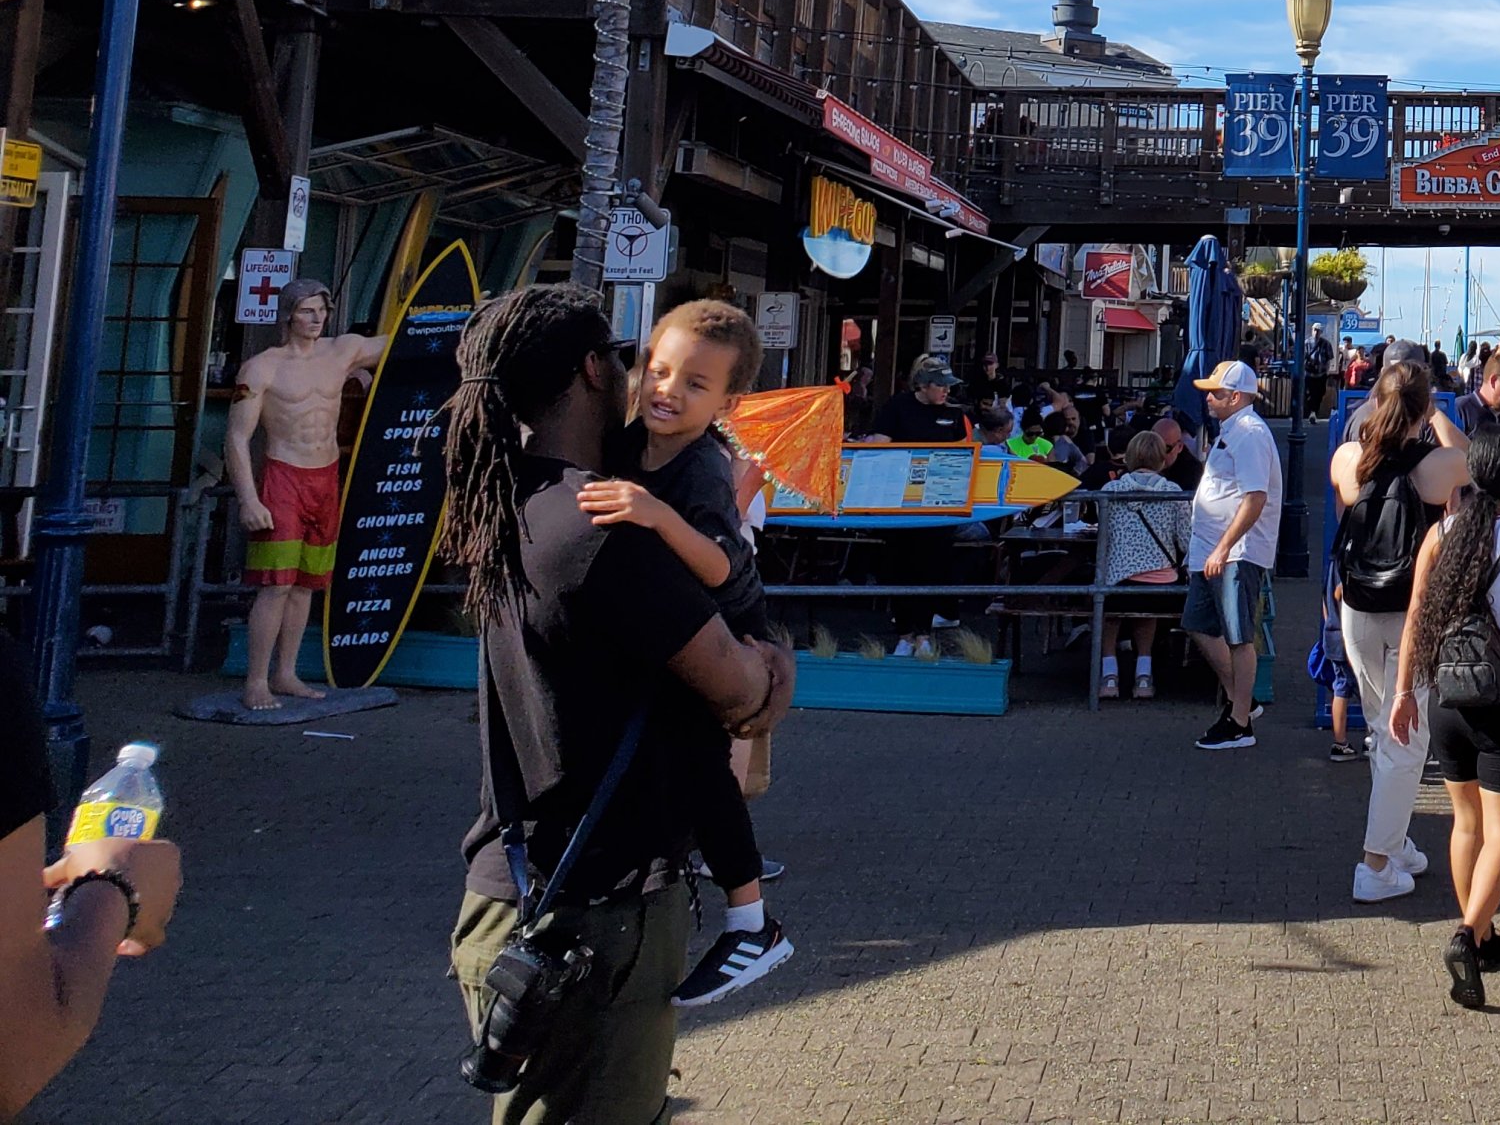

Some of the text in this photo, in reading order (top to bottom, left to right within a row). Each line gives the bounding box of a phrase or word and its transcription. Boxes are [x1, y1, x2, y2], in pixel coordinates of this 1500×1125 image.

[1234, 92, 1286, 111] PIER
[1326, 93, 1378, 113] PIER
[1230, 113, 1288, 157] 39
[1323, 115, 1380, 158] 39
[1482, 148, 1500, 162] End
[1415, 168, 1481, 195] BUBBA
[263, 254, 275, 263] NO
[245, 263, 289, 273] LIFEGUARD
[243, 308, 277, 318] ON DUT
[1344, 319, 1359, 330] 39
[401, 410, 434, 422] LIVE
[384, 426, 441, 440] SPORTS
[387, 463, 422, 476] FISH
[376, 479, 422, 493] TACOS
[357, 513, 424, 528] CHOWDER
[359, 547, 406, 561] ANGUS
[348, 563, 413, 579] BURGERS
[346, 599, 391, 613] PIZZA
[331, 631, 389, 647] SALADS
